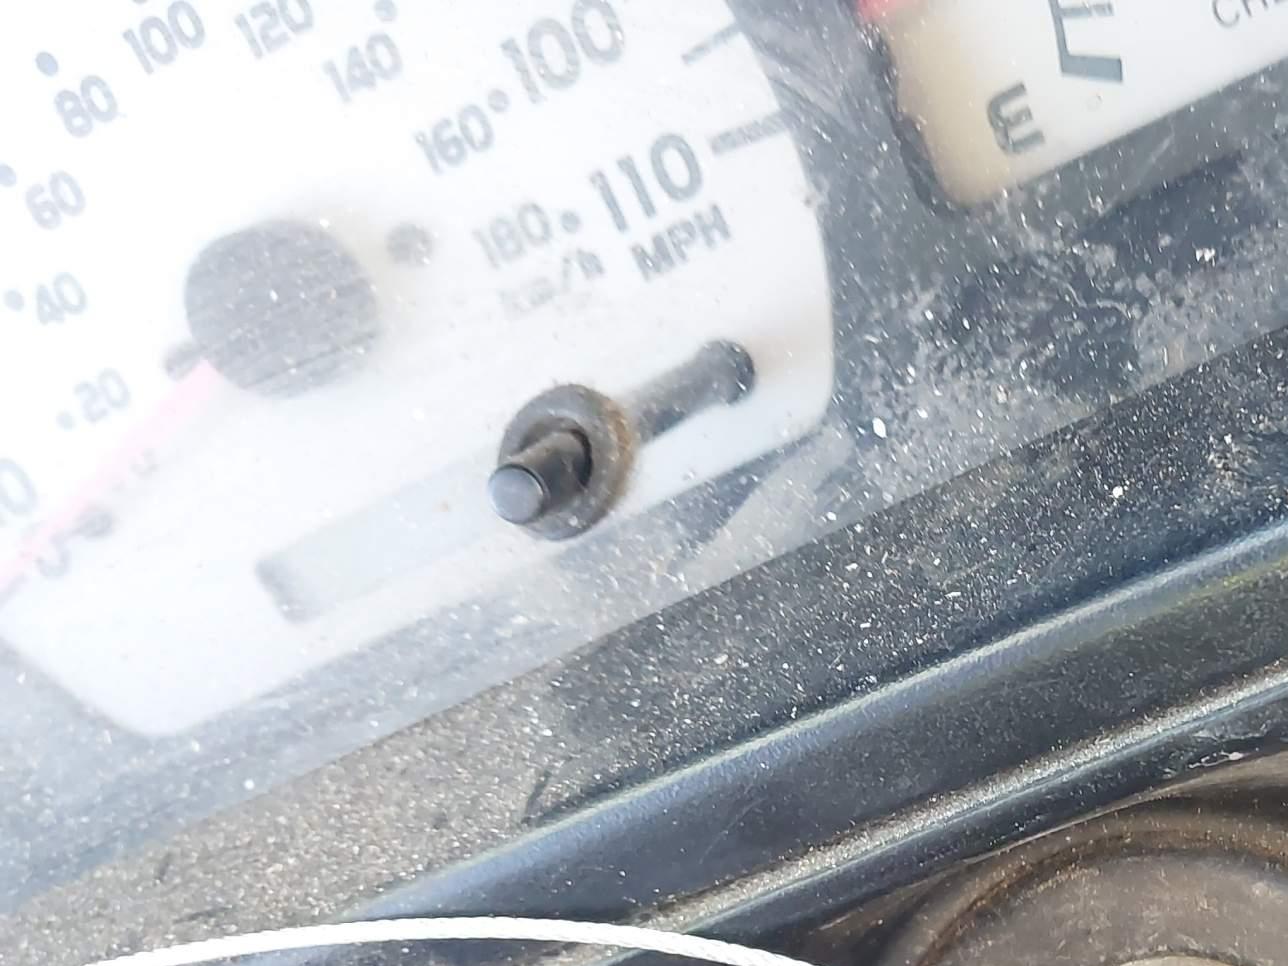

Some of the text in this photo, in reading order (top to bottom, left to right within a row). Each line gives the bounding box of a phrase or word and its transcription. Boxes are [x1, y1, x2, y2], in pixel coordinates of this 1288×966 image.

[122, 0, 206, 75] 100
[234, 0, 314, 59] 120
[500, 0, 625, 105] 100
[322, 32, 403, 105] 140
[54, 74, 118, 138] 80
[413, 103, 494, 175] 160
[987, 82, 1046, 154] E
[25, 170, 86, 230] 60
[590, 133, 703, 233] 110
[472, 202, 553, 270] 180
[630, 203, 732, 283] MPH
[36, 271, 87, 326] 40
[73, 367, 131, 424] 20
